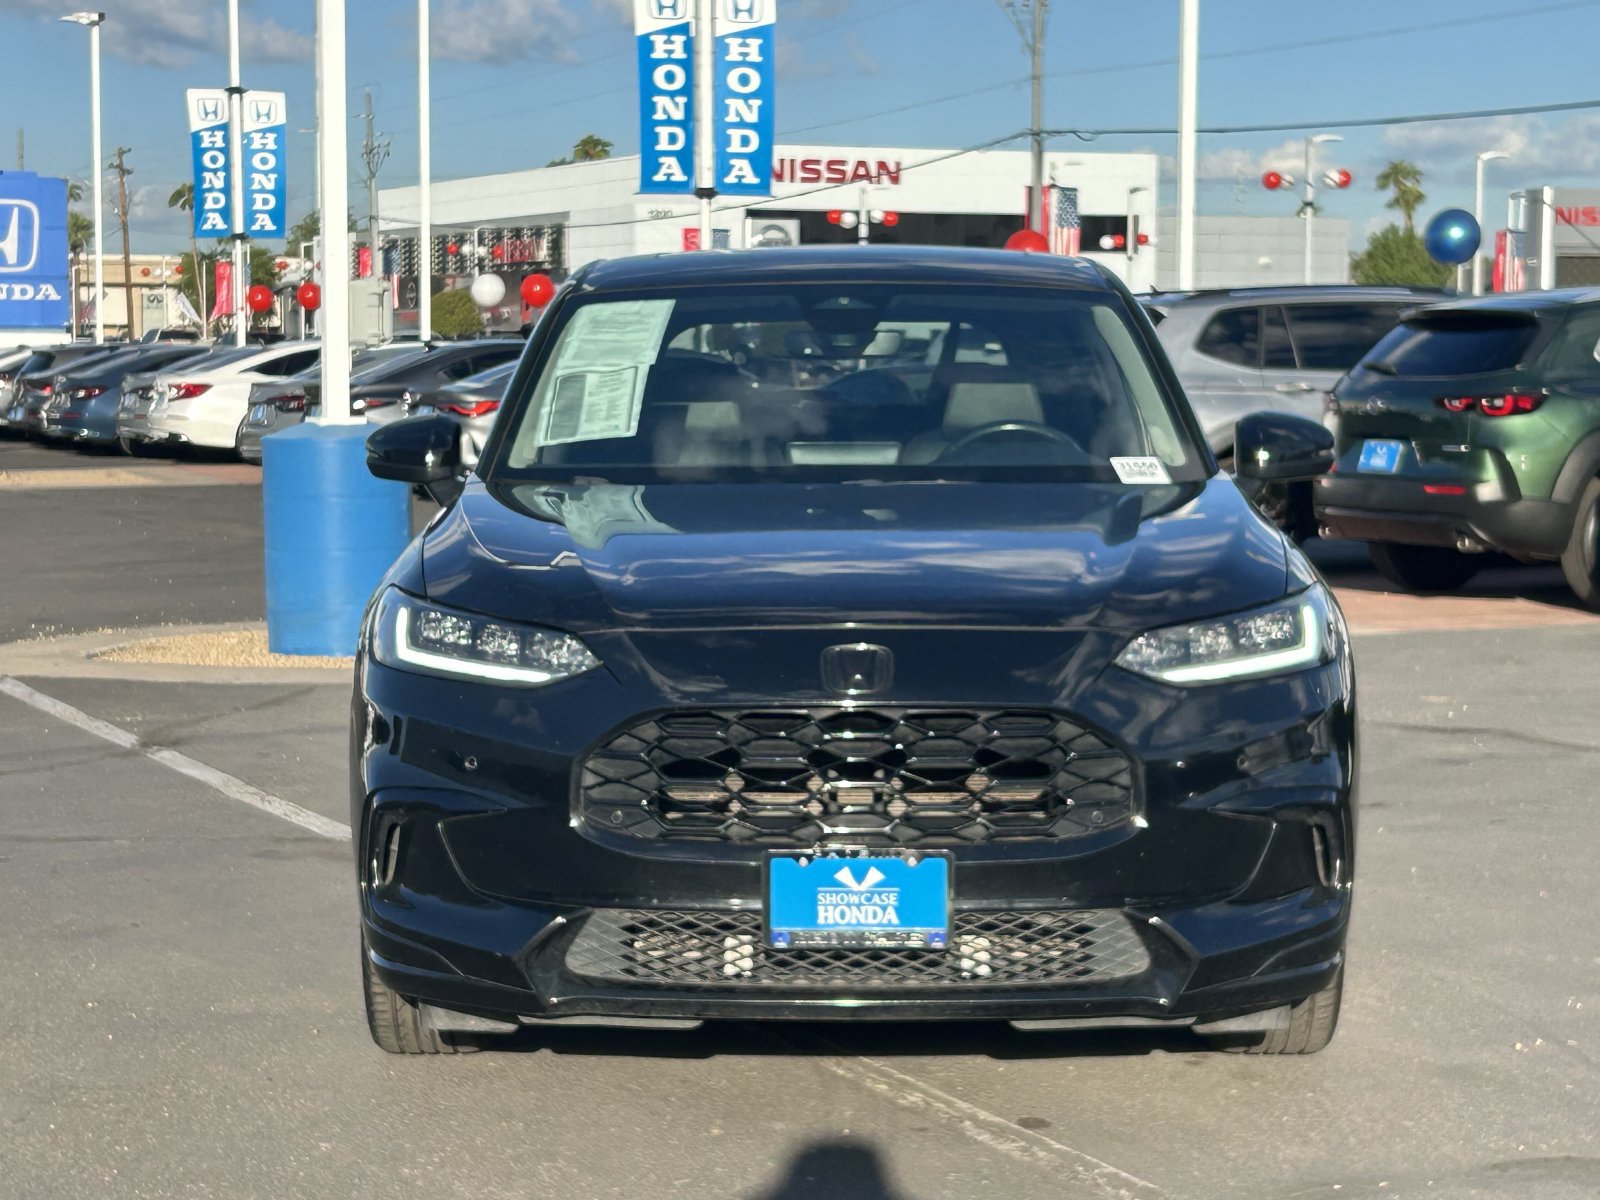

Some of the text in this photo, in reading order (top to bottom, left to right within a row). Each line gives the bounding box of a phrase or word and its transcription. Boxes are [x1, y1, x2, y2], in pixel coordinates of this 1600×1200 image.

[650, 34, 688, 182] HONDA
[723, 37, 764, 184] HONDA
[199, 130, 228, 230] HONDA
[249, 132, 278, 231] HONDA
[817, 892, 898, 905] SHOWCASE
[817, 905, 900, 925] HONDA
